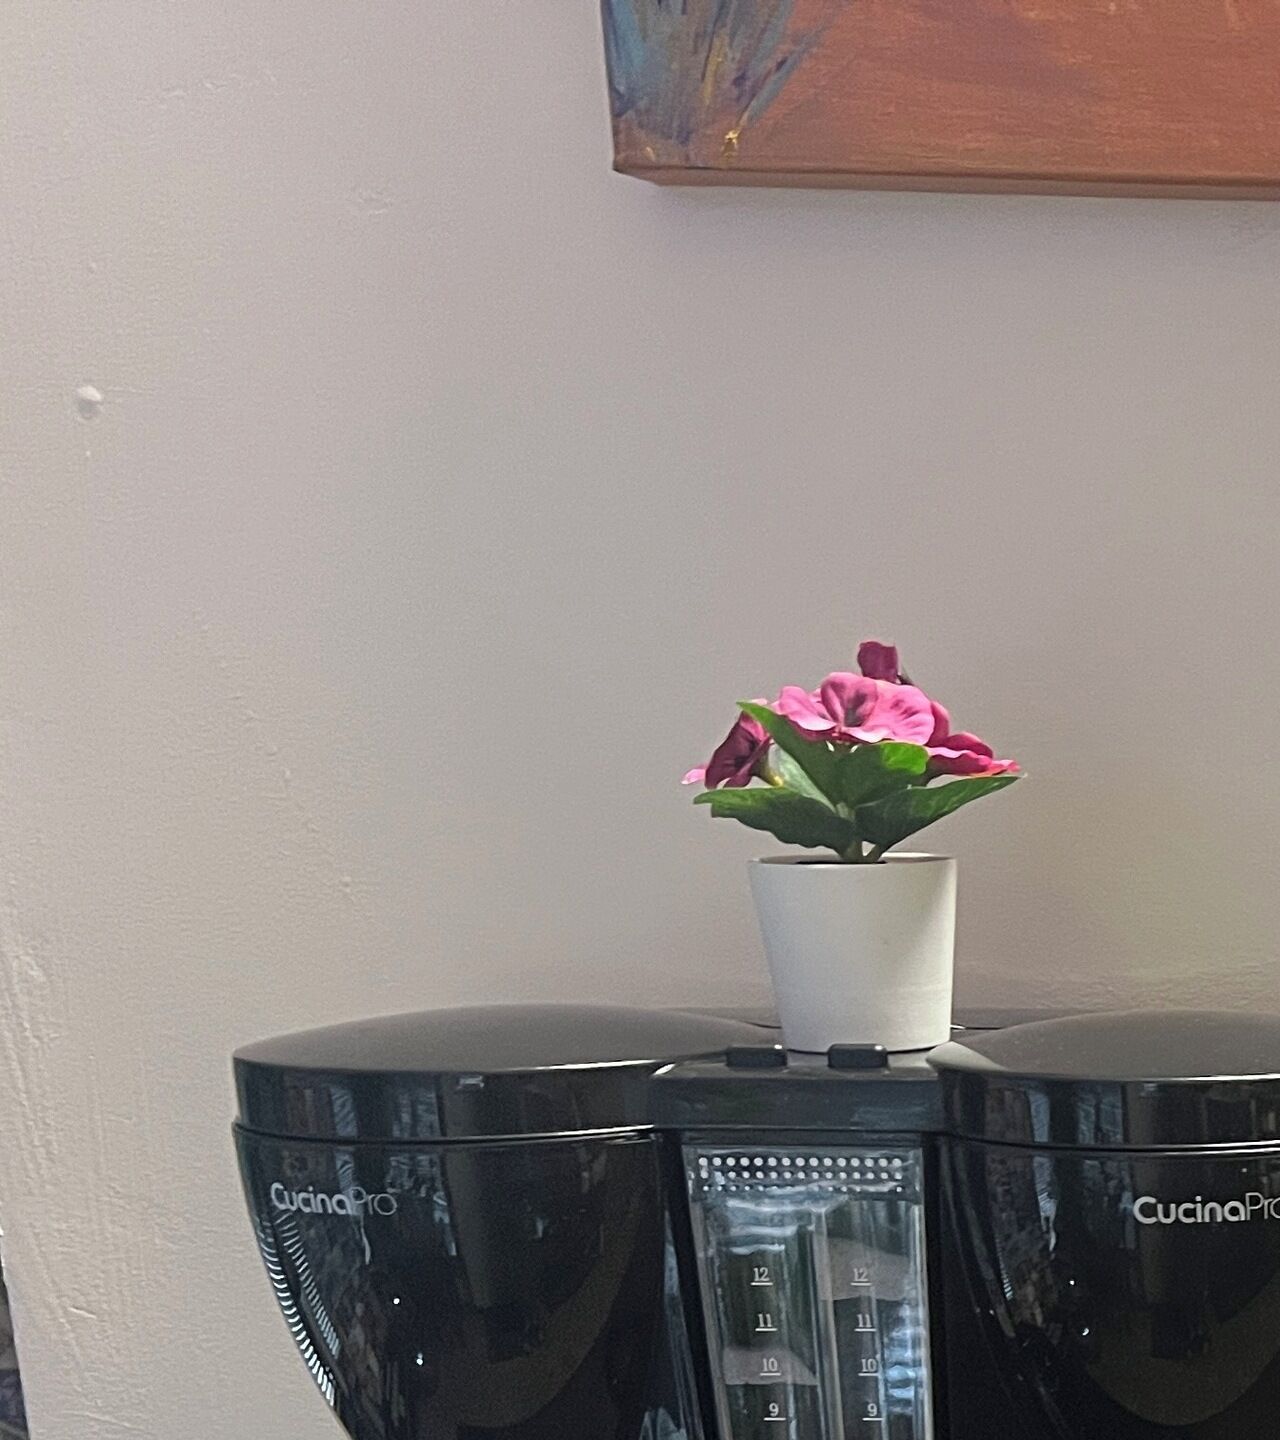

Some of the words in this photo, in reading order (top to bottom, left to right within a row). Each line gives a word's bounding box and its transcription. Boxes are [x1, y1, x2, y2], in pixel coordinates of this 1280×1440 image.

[752, 1267, 770, 1282] 12
[853, 1268, 869, 1282] 12
[757, 1313, 773, 1328] 11
[856, 1314, 872, 1328] 11
[761, 1357, 778, 1372] 10
[861, 1358, 878, 1372] 10
[769, 1404, 779, 1418] 9
[867, 1404, 877, 1418] 9
